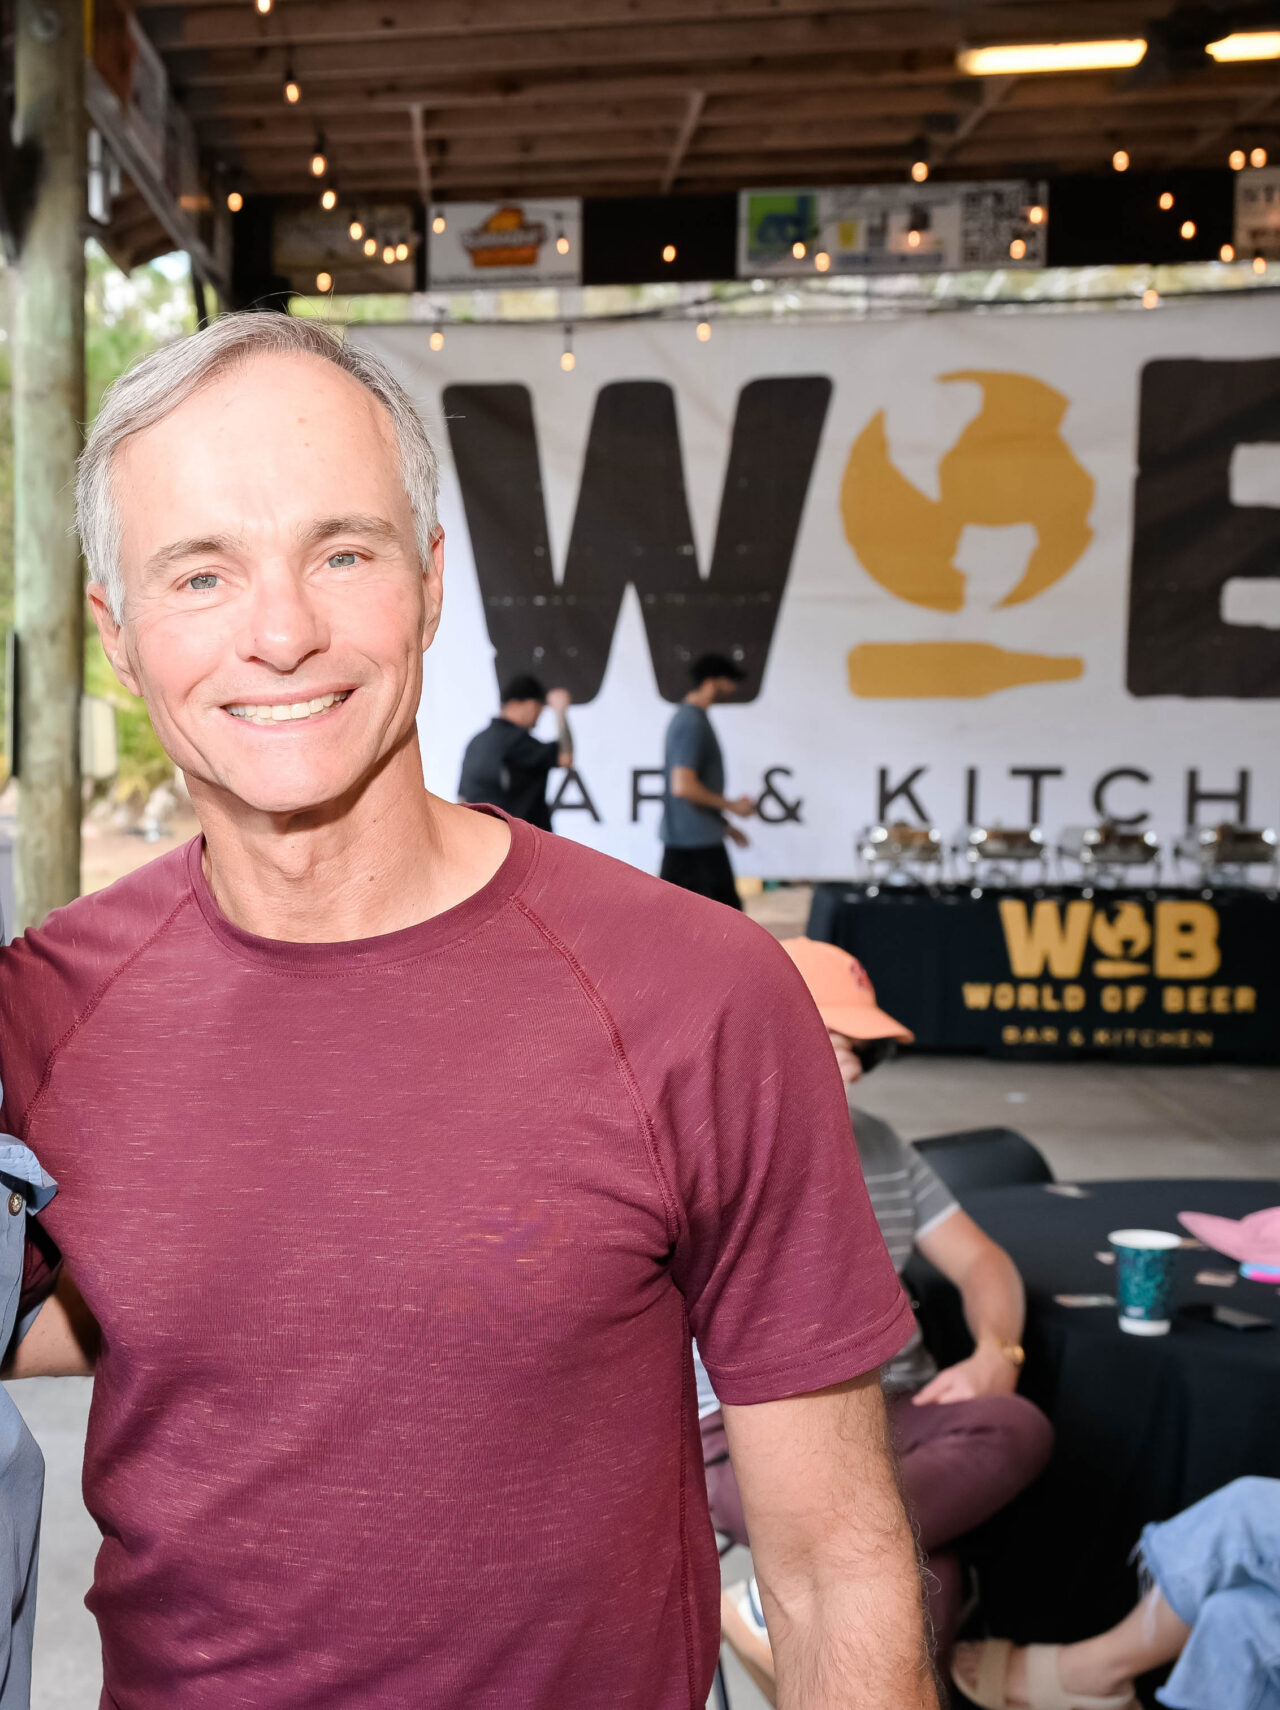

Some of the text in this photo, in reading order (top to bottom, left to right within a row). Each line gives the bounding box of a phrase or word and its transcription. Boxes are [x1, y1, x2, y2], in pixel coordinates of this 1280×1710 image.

[756, 766, 802, 825] &
[962, 983, 1257, 1014] WORLD OF BEER
[1001, 1025, 1059, 1046] BAR
[1092, 1027, 1214, 1048] KITCHEN
